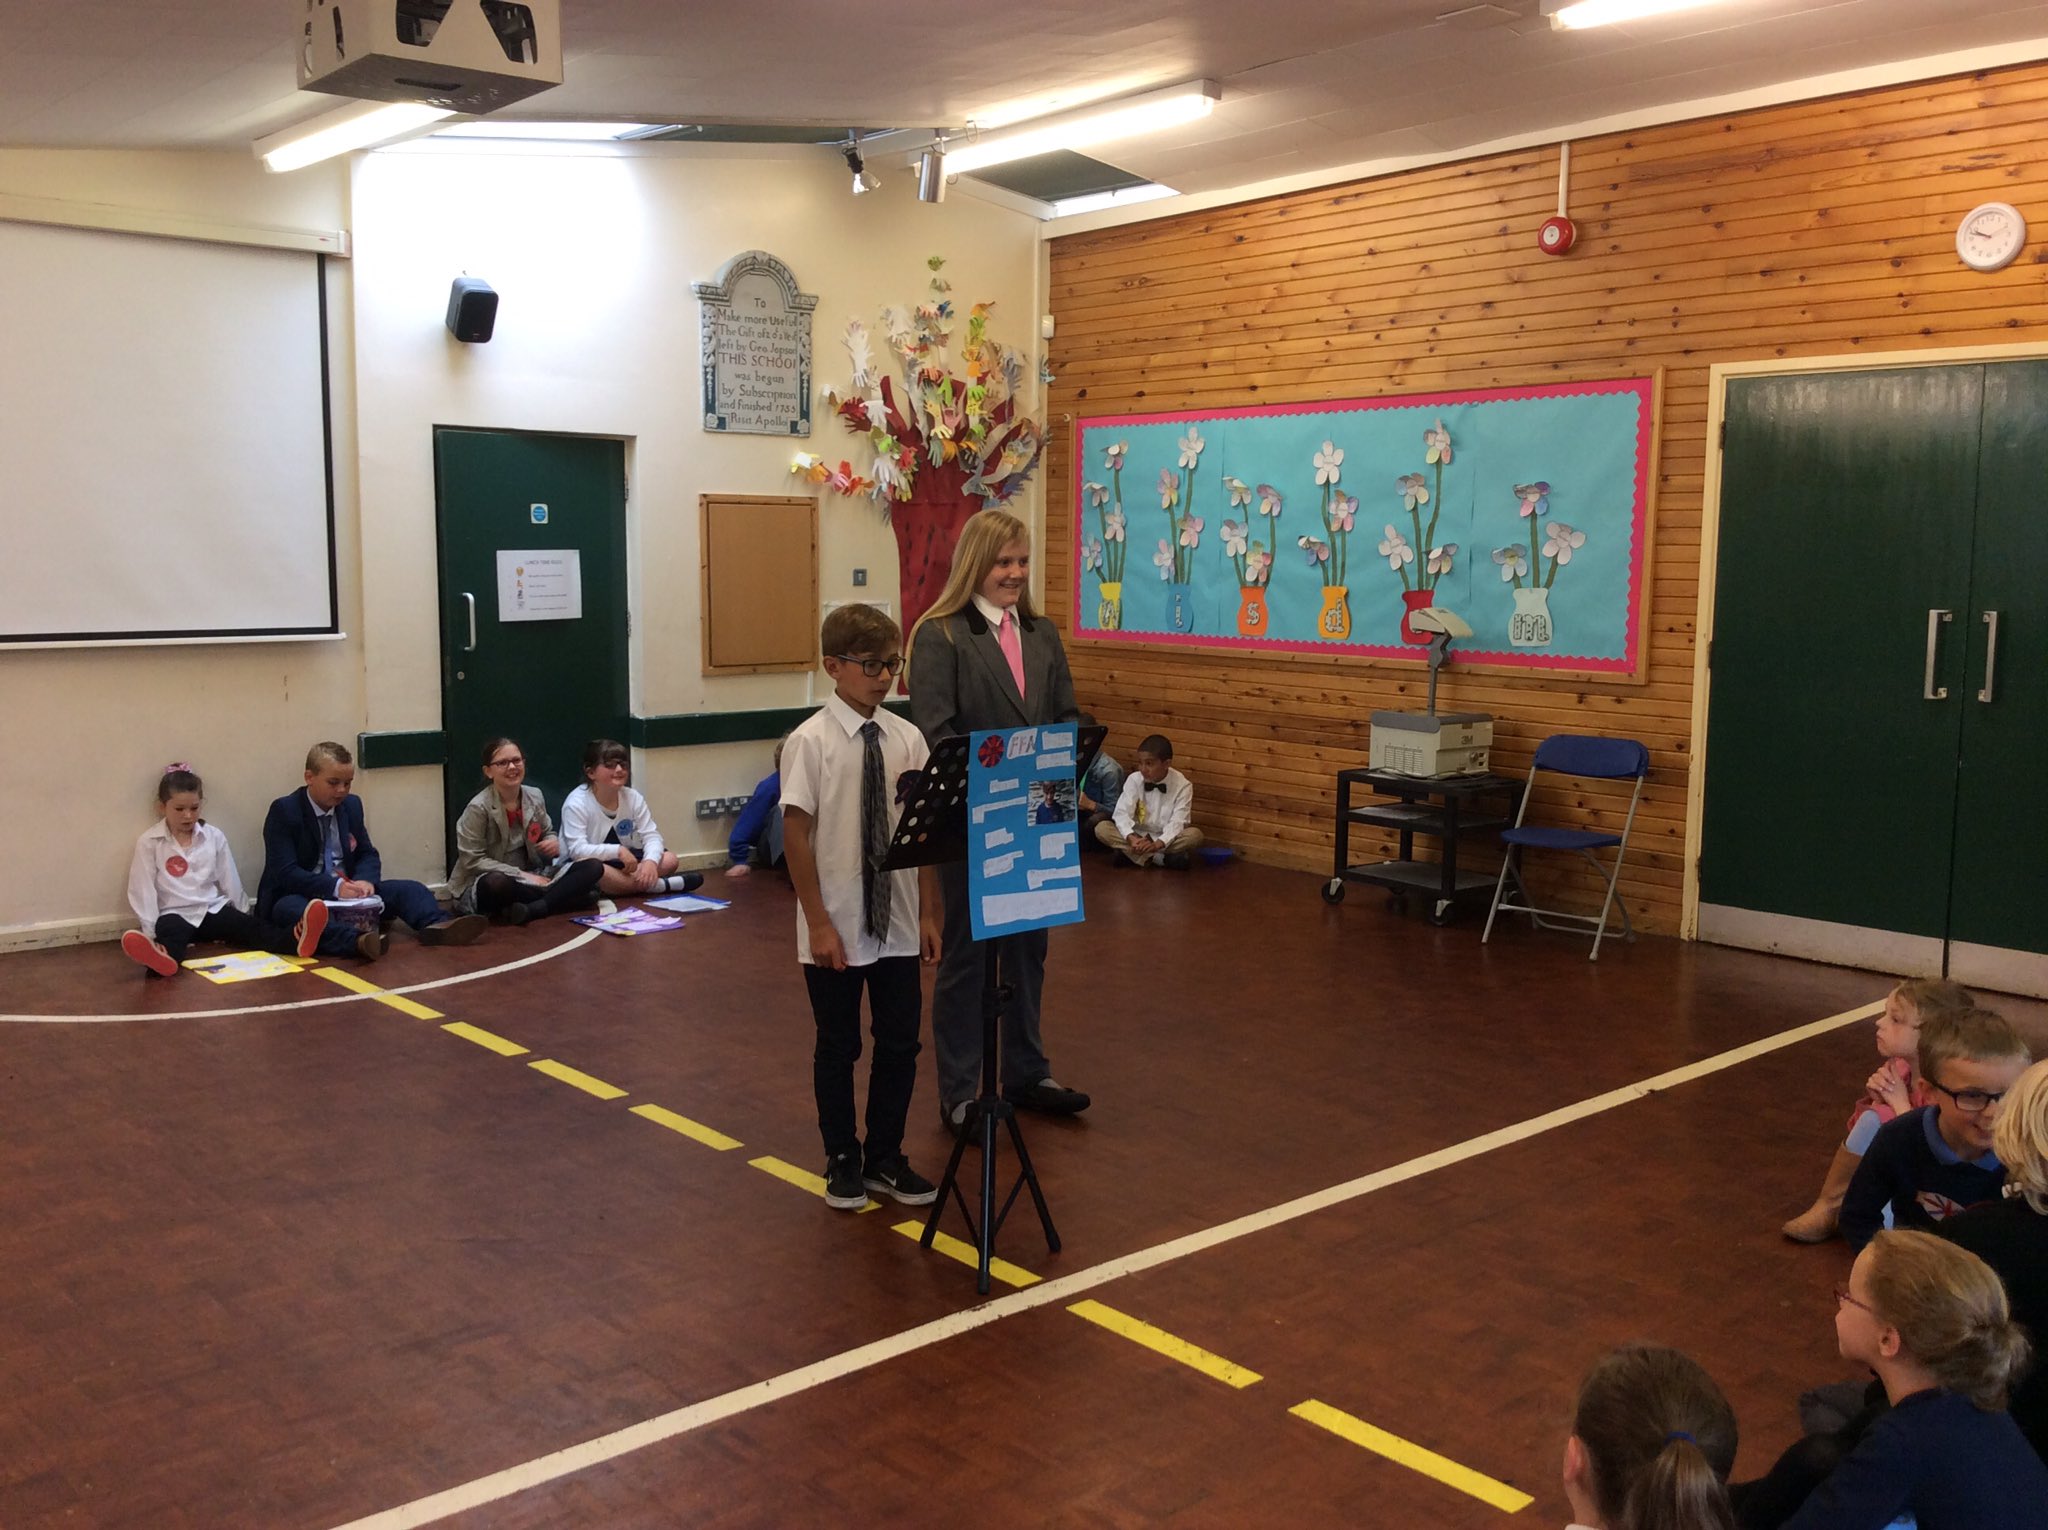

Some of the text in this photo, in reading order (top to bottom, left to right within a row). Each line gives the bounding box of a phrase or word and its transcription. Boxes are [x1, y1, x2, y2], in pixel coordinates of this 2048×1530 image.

[754, 297, 767, 309] To
[718, 307, 798, 327] Make more Useful
[717, 323, 737, 336] The
[736, 339, 748, 353] by
[718, 352, 797, 369] THIS SCHOOL
[734, 370, 785, 386] was begun
[721, 382, 797, 403] by Subscription
[719, 398, 736, 410] and
[737, 399, 772, 412] finished
[755, 414, 788, 429] Apollo
[1461, 735, 1474, 746] 3M
